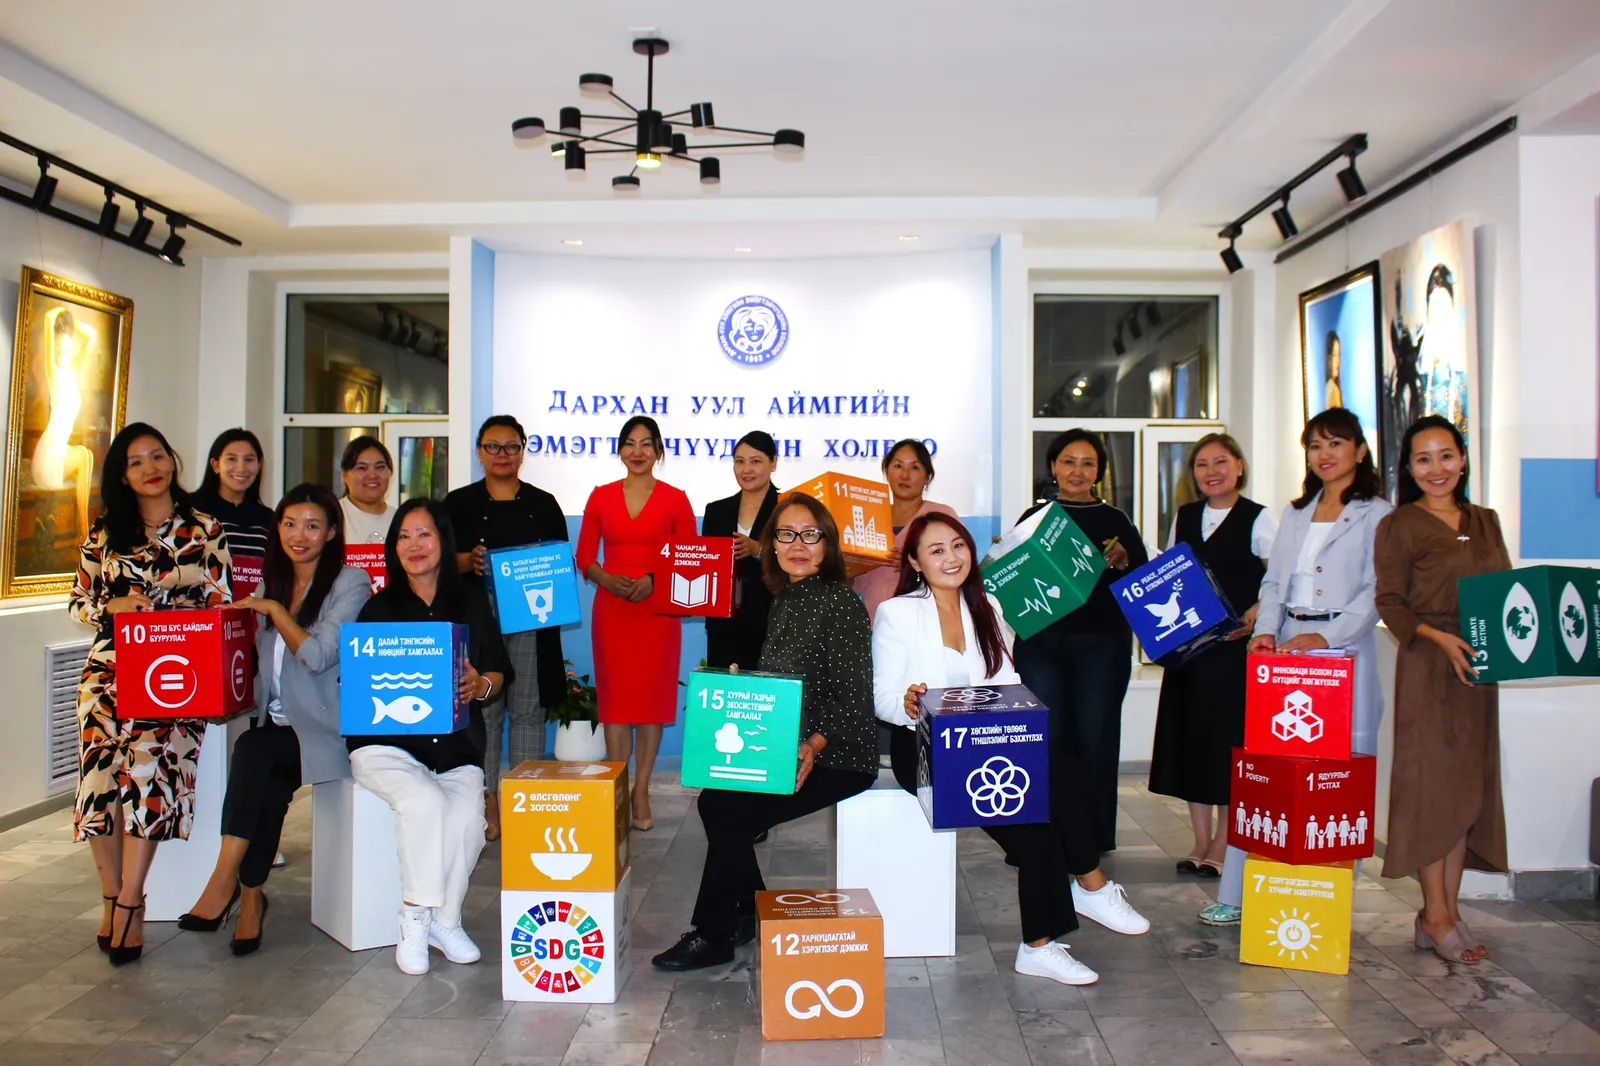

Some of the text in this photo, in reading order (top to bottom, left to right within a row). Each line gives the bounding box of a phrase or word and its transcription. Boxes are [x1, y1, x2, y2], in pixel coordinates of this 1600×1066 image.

[549, 389, 910, 414] ДАРХАН УУЛ АЙМГИЙН
[824, 438, 938, 458] ХОЛБО
[834, 481, 848, 497] 11
[660, 543, 671, 558] 4
[1041, 538, 1051, 551] 3
[675, 552, 720, 560] БОЛОВСРОЛЫГ
[242, 567, 261, 575] WORK
[501, 562, 511, 577] 6
[1141, 572, 1158, 584] PEACE,
[1175, 554, 1186, 565] AND
[1145, 560, 1193, 592] STRONG INSTITUTIONS
[983, 579, 997, 592] 3
[1122, 582, 1144, 602] 16
[121, 624, 146, 644] 10
[150, 622, 214, 633] ТЭГШ БУС БАЙДЛЫГ
[224, 621, 231, 640] 10
[1470, 617, 1478, 647] CLIMATE
[1478, 620, 1487, 646] ACTION
[150, 634, 186, 643] БУУРУУЛАХ
[378, 636, 435, 647] ДАЛАЙ ТЭНГИСИЙН
[349, 636, 375, 657] 14
[378, 647, 443, 657] НӨӨЦИЙГ ХАМГААЛАХ
[1257, 665, 1270, 683] 9
[1272, 667, 1347, 678] ИННОВАЦИ БОЛОН ДЭД
[1302, 678, 1340, 687] ХӨГЖҮҮЛЭХ
[698, 688, 724, 710] 15
[727, 691, 776, 702] ХУУРАЙ ГАЗРЫН
[726, 701, 775, 712] ЭКОСИСТЕМИЙГ
[725, 711, 762, 720] ХАМГААЛАХ
[970, 724, 1027, 735] ХӨГЖЛИЙН ТӨЛӨӨХ
[940, 727, 968, 749] 17
[971, 733, 1044, 746] ТҮНШЛЭЛИЙГ БЭХЖҮҮЛЭХ
[1237, 760, 1243, 778] 1
[1246, 763, 1254, 771] NO
[1246, 772, 1270, 784] POVERTY
[1306, 773, 1314, 791] 1
[1318, 771, 1350, 781] ЯДУУРЛЫГ
[1318, 782, 1341, 790] УСТГАХ
[513, 792, 526, 812] 2
[1253, 874, 1266, 893] 7
[801, 931, 856, 942] ХАРИУЦЛАГАТАЙ
[534, 938, 580, 960] SDG
[771, 933, 800, 956] 12
[801, 943, 869, 954] ХЭРЭГЛЭЭГ ДЭМЖИХ
